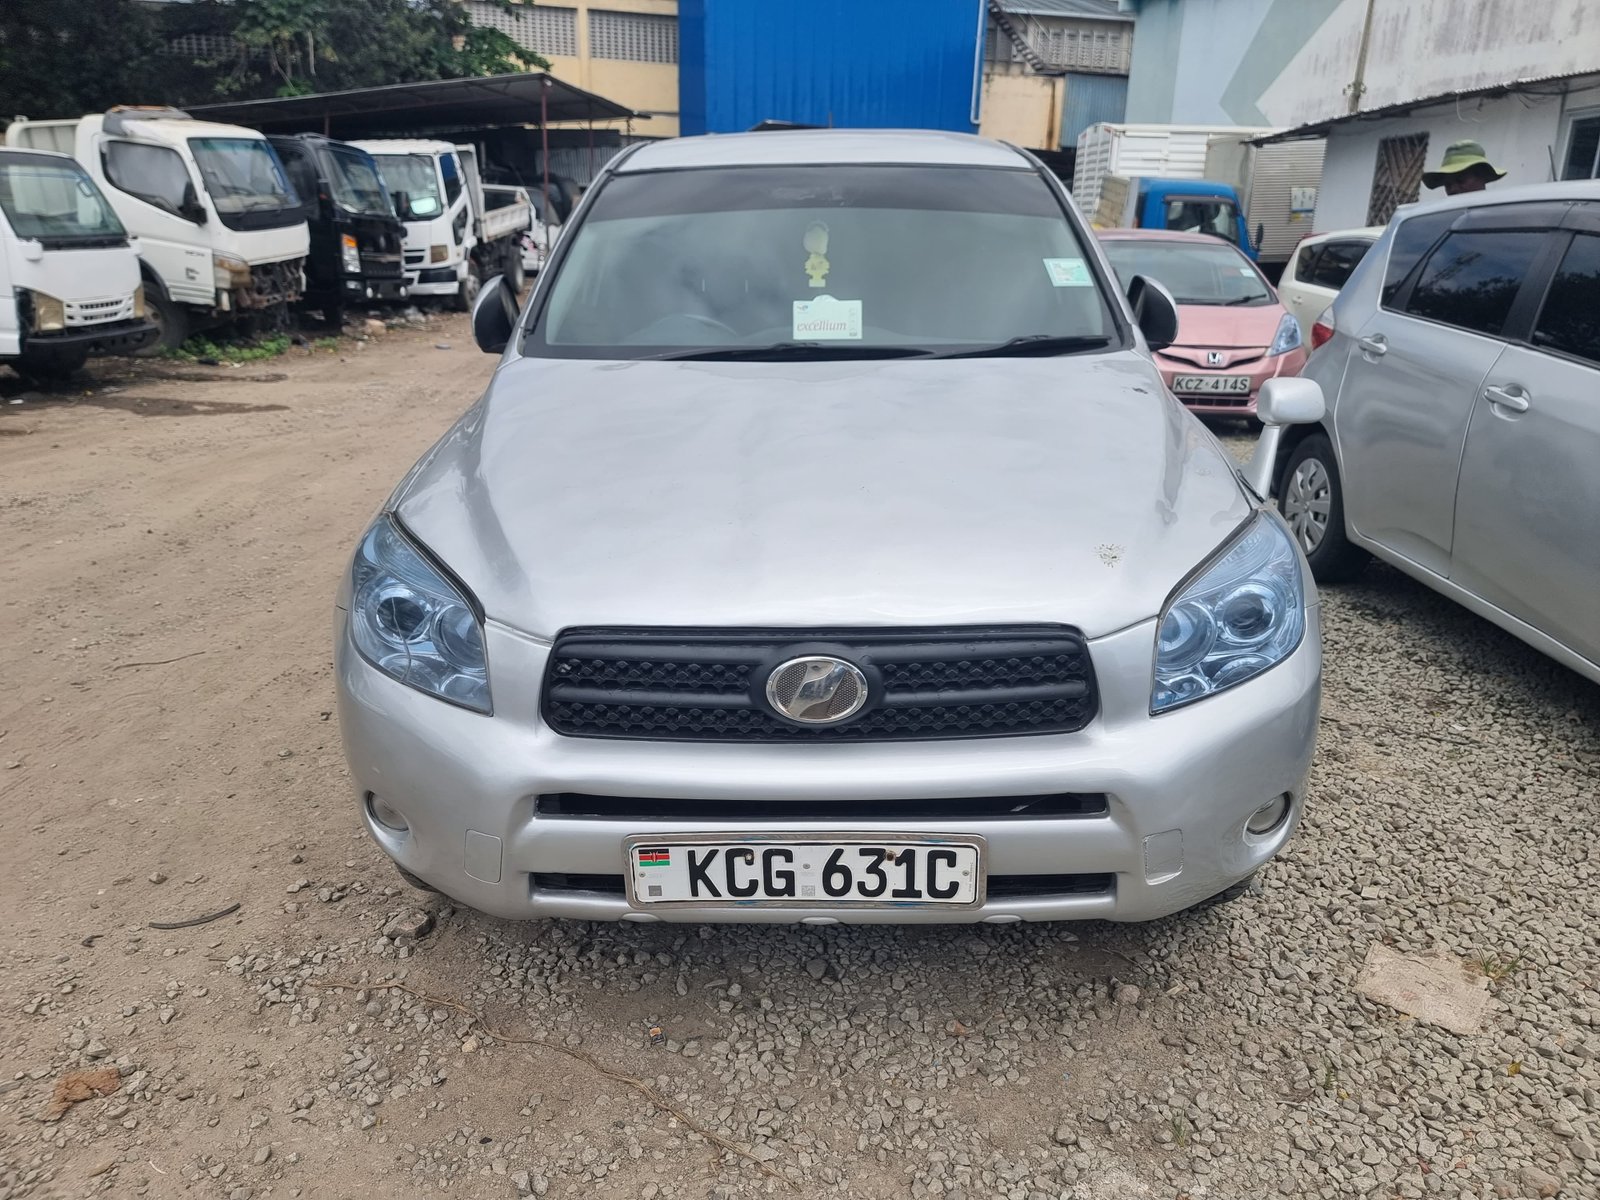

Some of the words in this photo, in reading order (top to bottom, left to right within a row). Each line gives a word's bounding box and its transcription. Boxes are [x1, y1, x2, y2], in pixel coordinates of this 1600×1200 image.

[796, 319, 847, 332] excellium
[1174, 377, 1203, 391] KCZ
[1211, 377, 1248, 391] 414S
[687, 847, 796, 898] KCG
[821, 847, 960, 900] 631C
